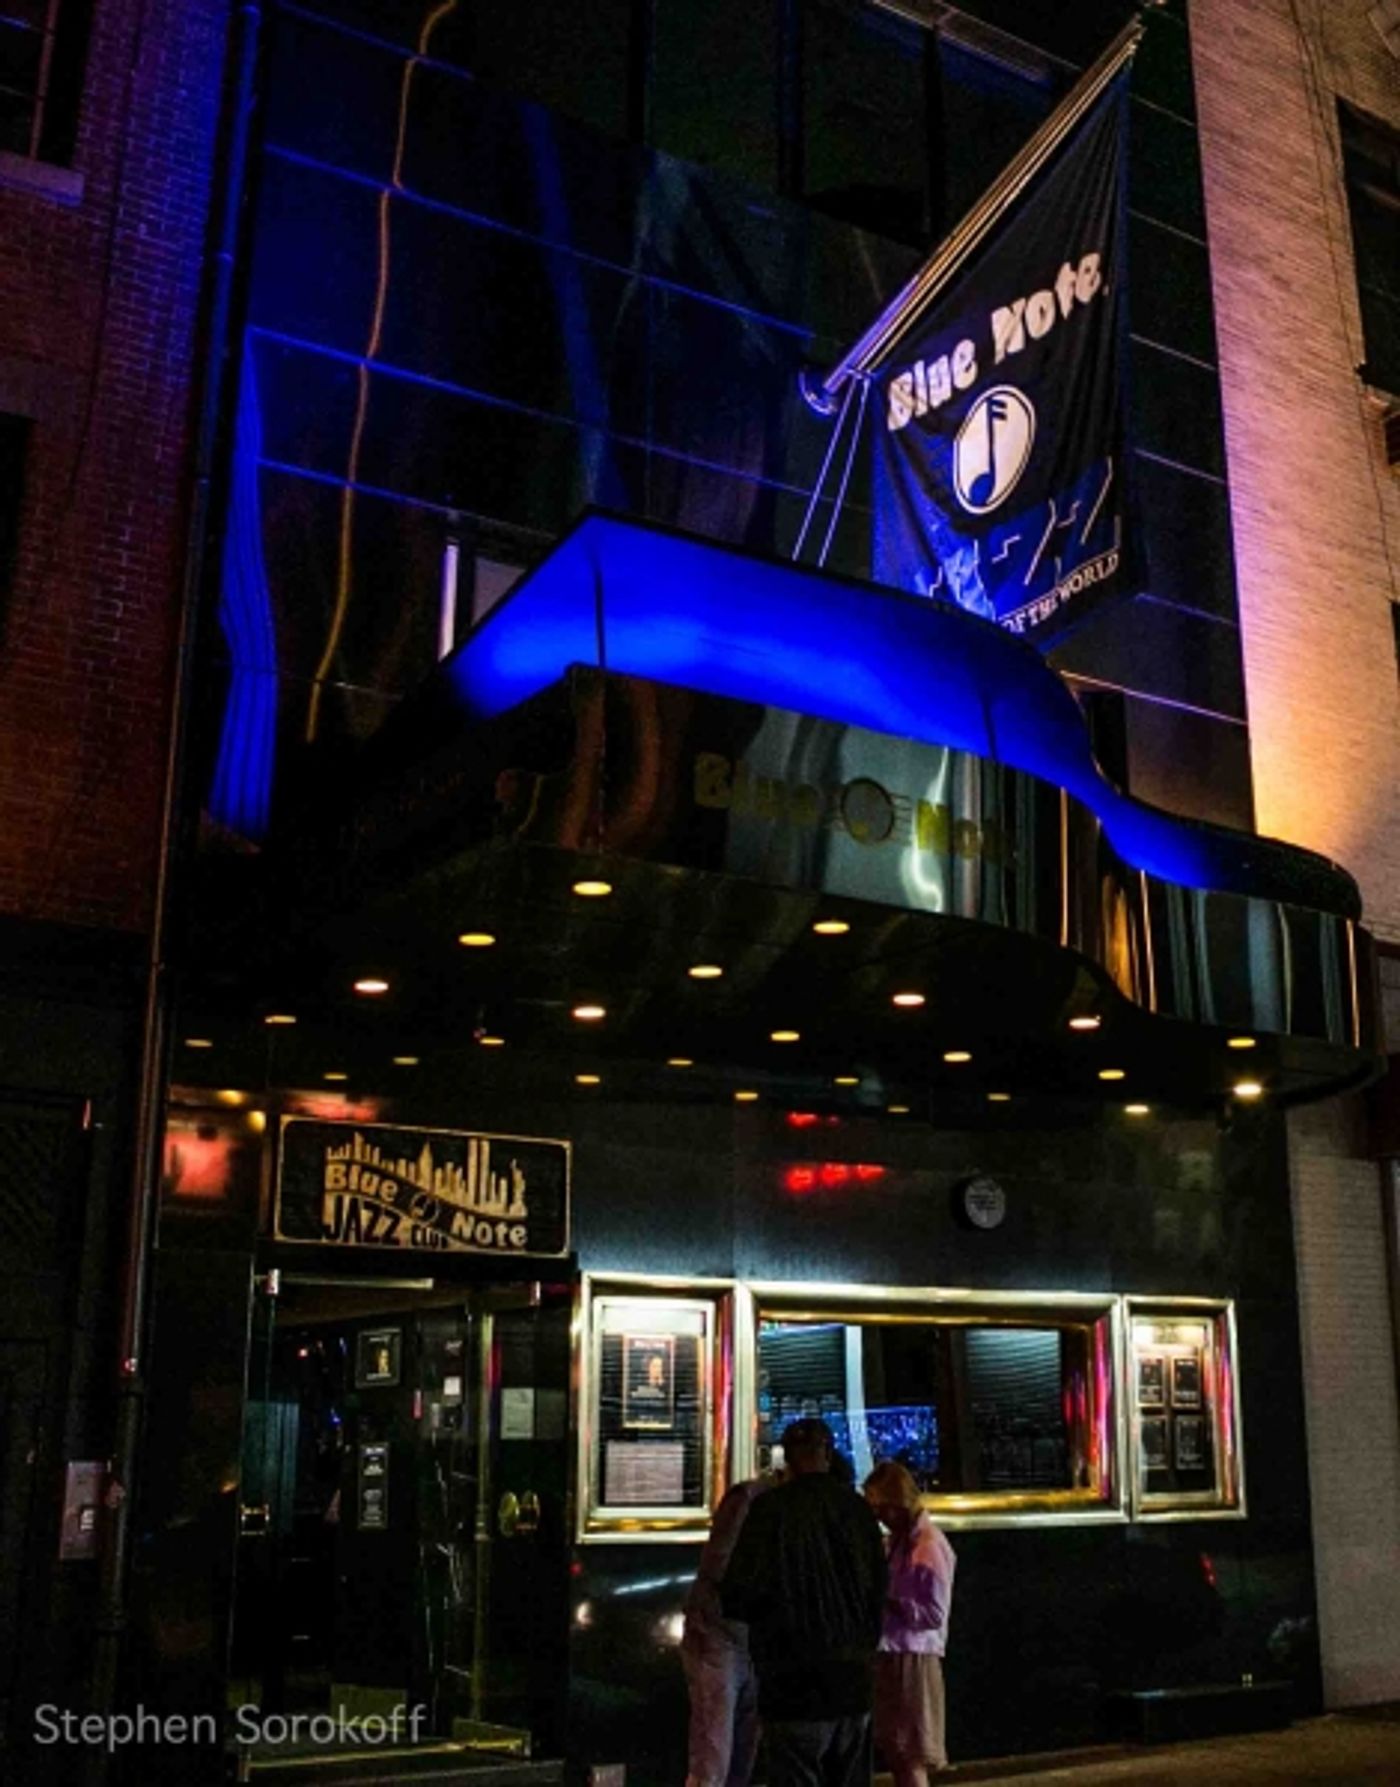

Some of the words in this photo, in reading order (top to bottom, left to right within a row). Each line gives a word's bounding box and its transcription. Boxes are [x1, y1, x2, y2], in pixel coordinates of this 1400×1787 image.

[888, 339, 978, 431] Blue
[991, 253, 1101, 364] Note
[1060, 553, 1119, 602] WORLD
[322, 1194, 401, 1246] JAZZ
[325, 1163, 399, 1203] Blue
[452, 1211, 528, 1247] Note
